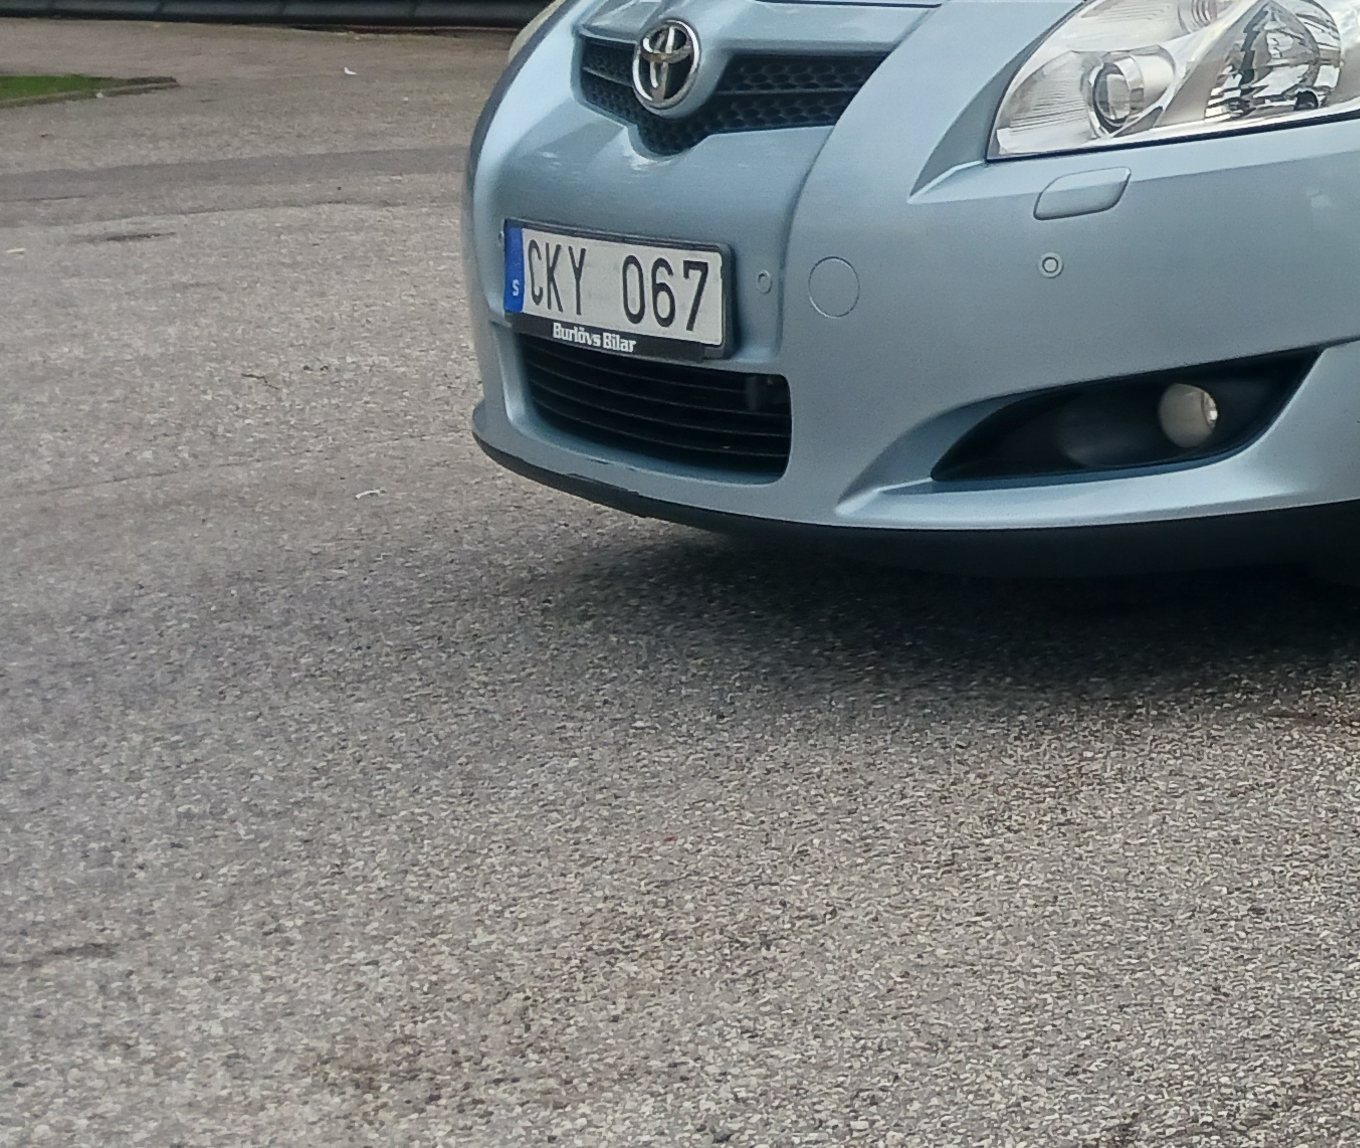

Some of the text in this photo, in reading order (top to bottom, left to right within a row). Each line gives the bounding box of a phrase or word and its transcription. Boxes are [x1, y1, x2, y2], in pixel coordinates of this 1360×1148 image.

[512, 278, 521, 297] S
[527, 238, 709, 332] CKY 067
[552, 322, 637, 353] Burlövs Bilar
